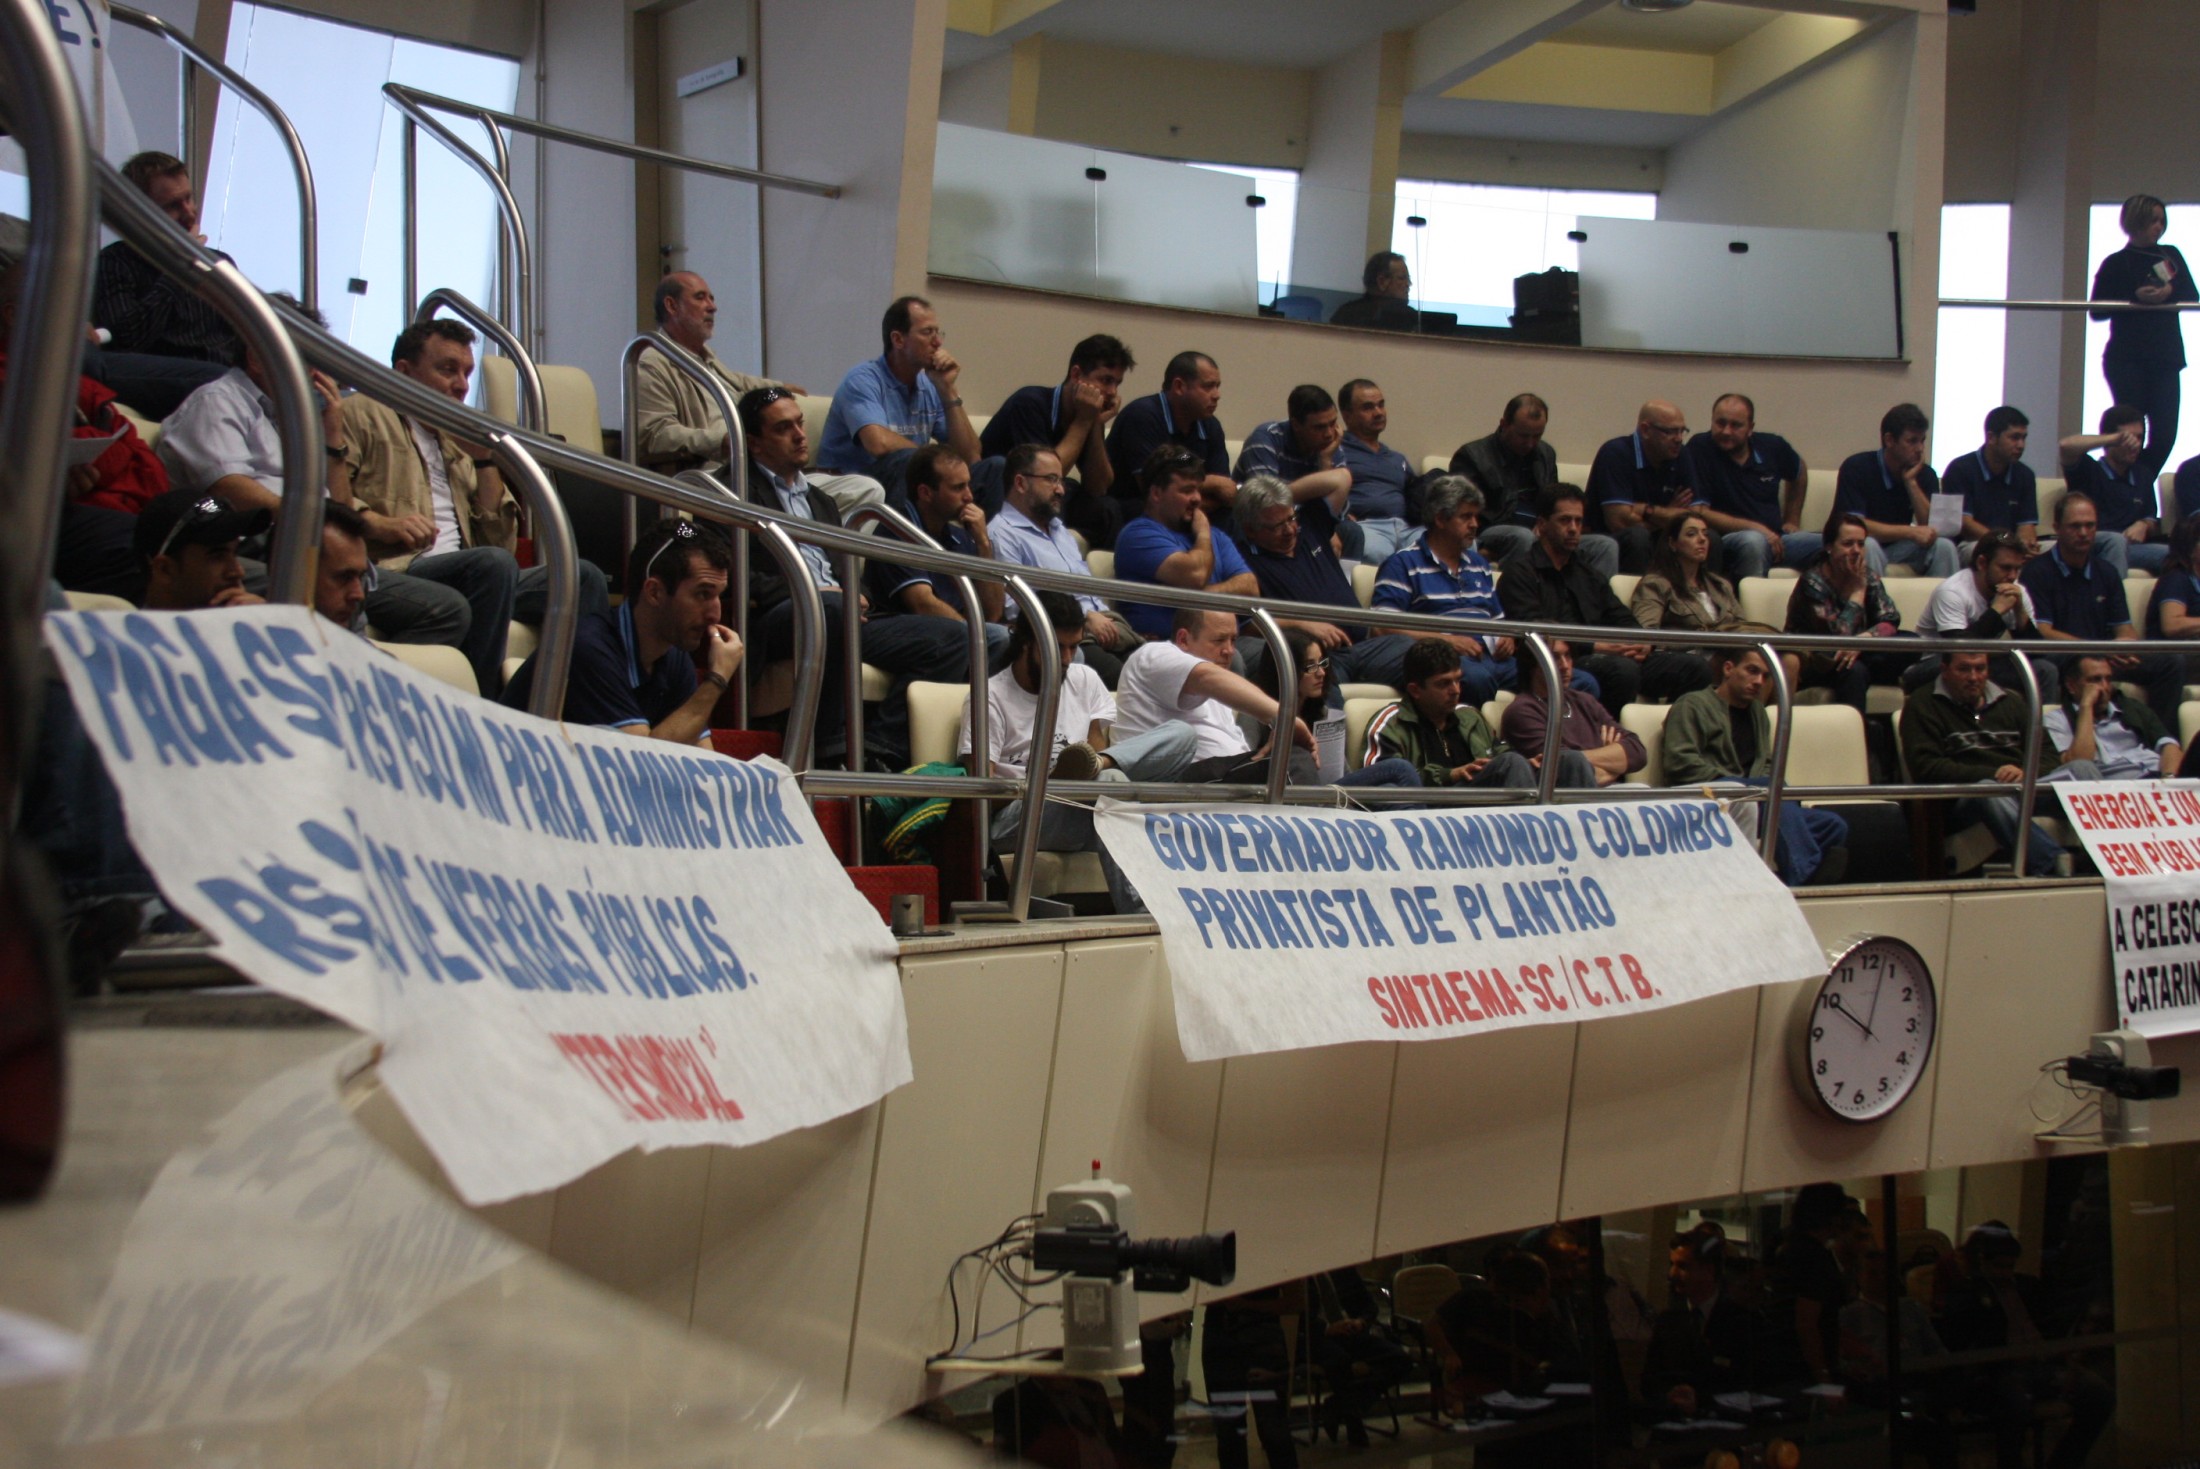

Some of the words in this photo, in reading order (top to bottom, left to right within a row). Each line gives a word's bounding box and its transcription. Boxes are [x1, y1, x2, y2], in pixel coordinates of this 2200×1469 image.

[481, 716, 599, 843] PARA
[574, 742, 804, 850] ADMINISTRAR
[2067, 791, 2163, 830] ENERGIA
[2151, 782, 2178, 827] É
[1144, 812, 1401, 873] GOVERNADOR
[1391, 811, 1578, 871] RAIMUNDO
[1577, 802, 1733, 859] COLOMBO
[2097, 842, 2153, 877] BEM
[2141, 832, 2200, 874] PÚBLI
[1177, 887, 1395, 949] PRIVATISTA
[1390, 886, 1457, 945] DE
[1452, 866, 1617, 941] PLANTÃO
[413, 853, 608, 994] VERBAS
[567, 866, 759, 1000] PÚBLICAS.
[2114, 908, 2128, 952] A
[2131, 899, 2200, 951] CELESC
[1861, 954, 1879, 970] 12
[1840, 967, 1854, 983] 11
[1888, 963, 1895, 979] 1
[1821, 992, 1841, 1009] 10
[1902, 987, 1913, 1002] 2
[1905, 1018, 1916, 1033] 3
[1812, 1027, 1824, 1042] 9
[1896, 1051, 1907, 1065] 4
[1816, 1059, 1827, 1075] 8
[1834, 1081, 1844, 1097] 7
[1878, 1077, 1888, 1092] 5
[1853, 1089, 1865, 1105] 6
